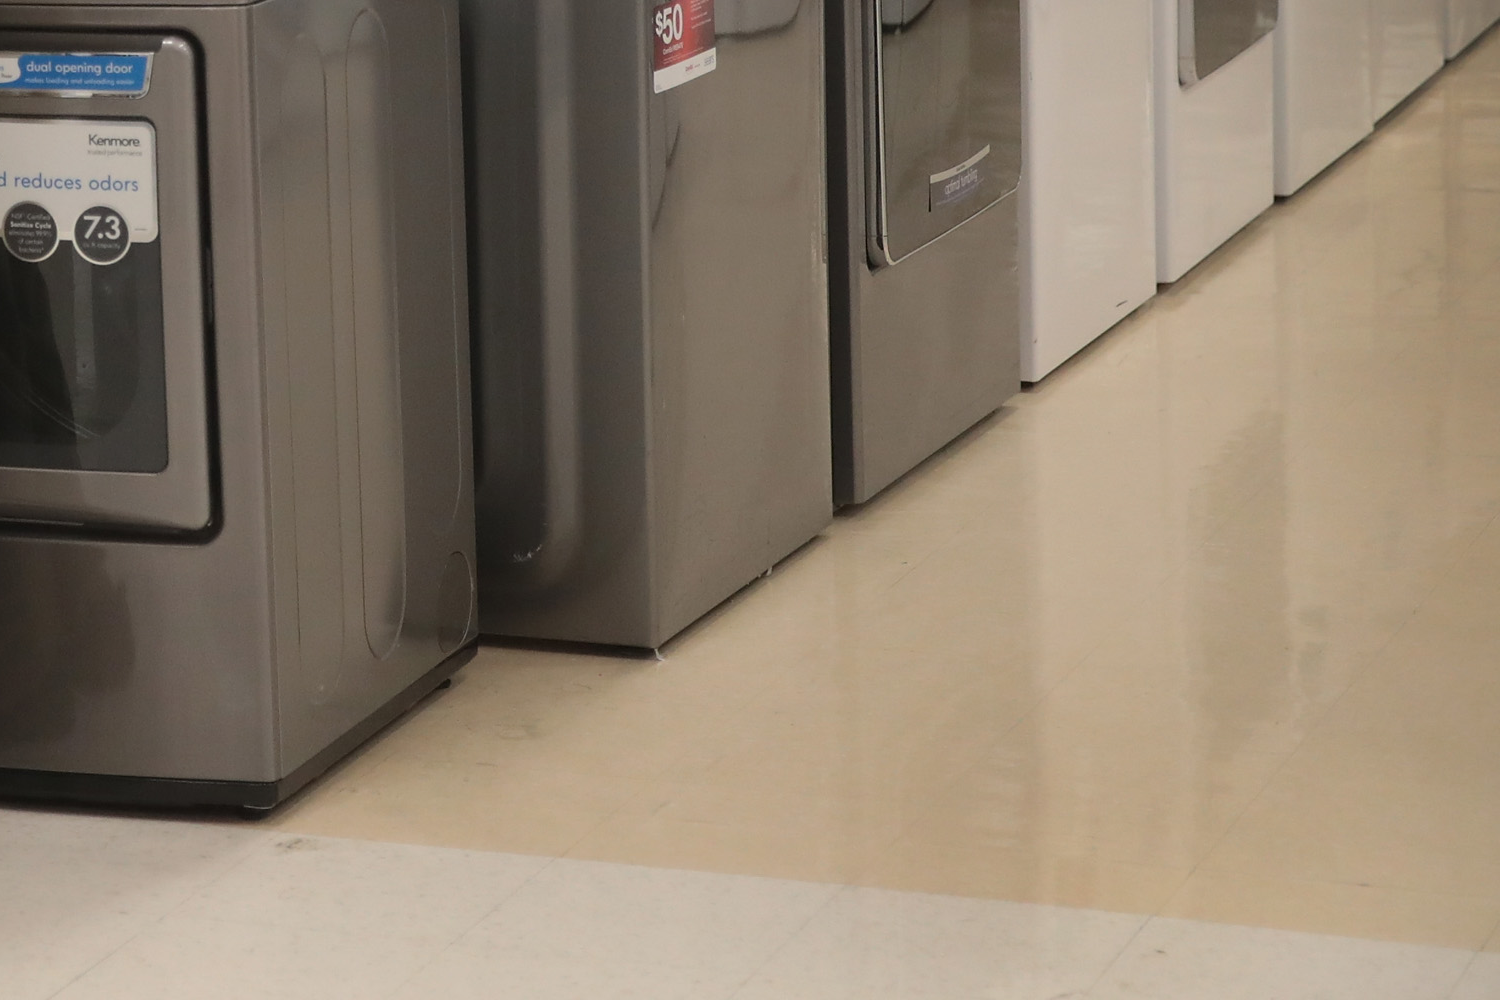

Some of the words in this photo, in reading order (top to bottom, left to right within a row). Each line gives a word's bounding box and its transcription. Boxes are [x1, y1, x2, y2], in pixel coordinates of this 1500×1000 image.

[655, 3, 683, 45] $50
[26, 61, 52, 72] dual
[55, 62, 102, 77] opening
[105, 62, 134, 74] door
[88, 134, 141, 147] Kenmore
[14, 172, 82, 190] reduces
[88, 174, 139, 192] odors
[35, 221, 52, 230] Cycle
[83, 215, 121, 240] 7.3
